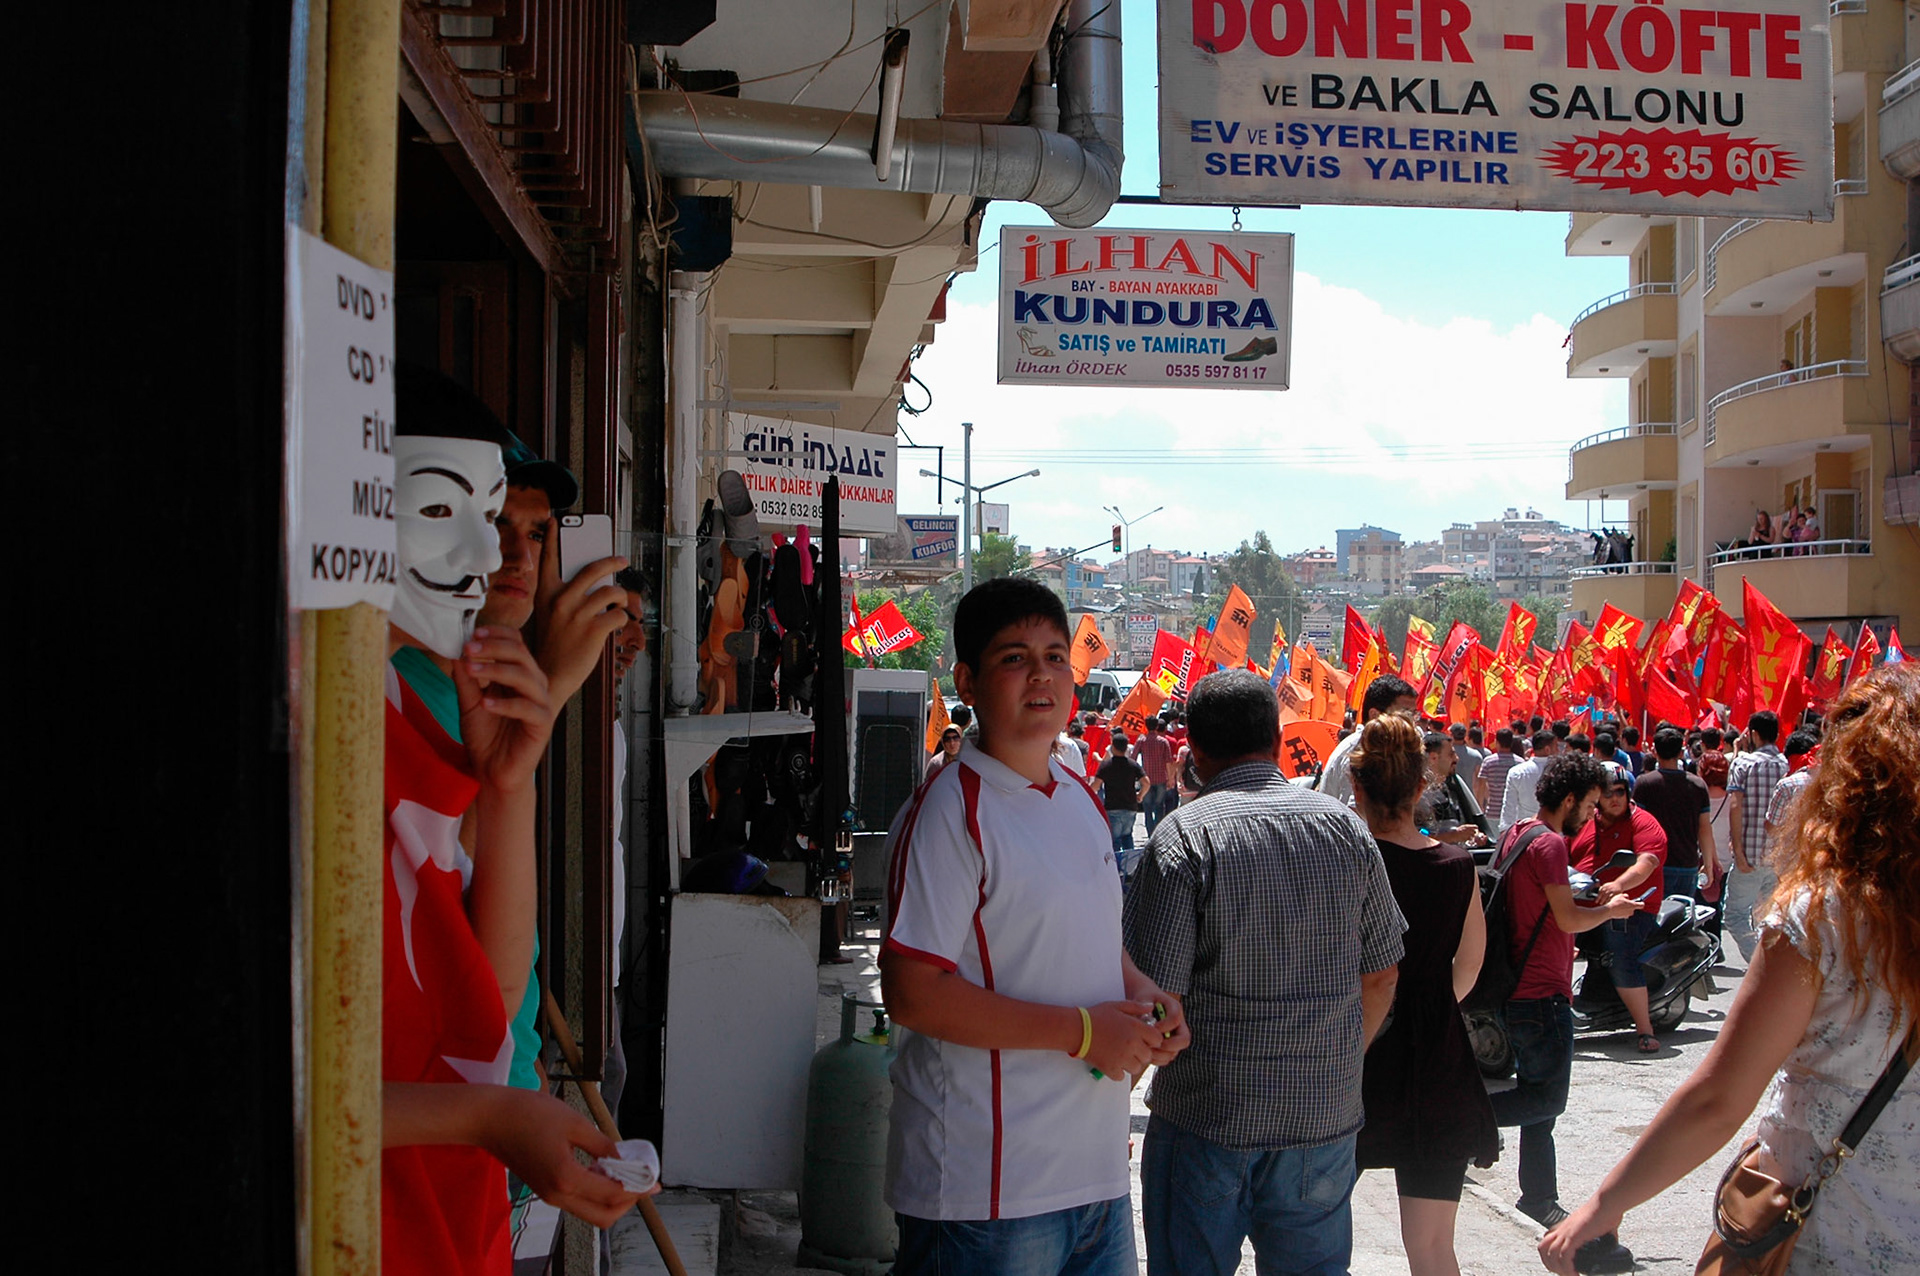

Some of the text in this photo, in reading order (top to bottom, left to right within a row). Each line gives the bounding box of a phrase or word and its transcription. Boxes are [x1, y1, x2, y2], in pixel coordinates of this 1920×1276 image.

[1565, 0, 1803, 80] KÖFTE
[1262, 73, 1744, 127] VE BAKLA SALONU
[1190, 120, 1241, 144] EV
[1247, 129, 1268, 146] VE
[1363, 157, 1510, 185] YAPILIR
[1573, 143, 1776, 182] 223 35 60
[1019, 234, 1265, 293] İLHAN
[1071, 280, 1096, 293] BAY
[1109, 280, 1151, 294] BAYAN
[1155, 281, 1218, 296] AYAKKABI
[1014, 290, 1278, 331] KUNDURA
[1058, 332, 1226, 356] SATIŞ ve TAMİRATI
[1066, 360, 1128, 376] ÖRDEK
[1165, 364, 1200, 378] 0535
[1204, 365, 1230, 379] 597
[1232, 366, 1249, 379] 81
[1252, 367, 1267, 380] 17
[741, 474, 894, 504] ATILIK DAİRE V ÜKKANLAR
[761, 500, 787, 516] 0532
[790, 502, 809, 518] 632
